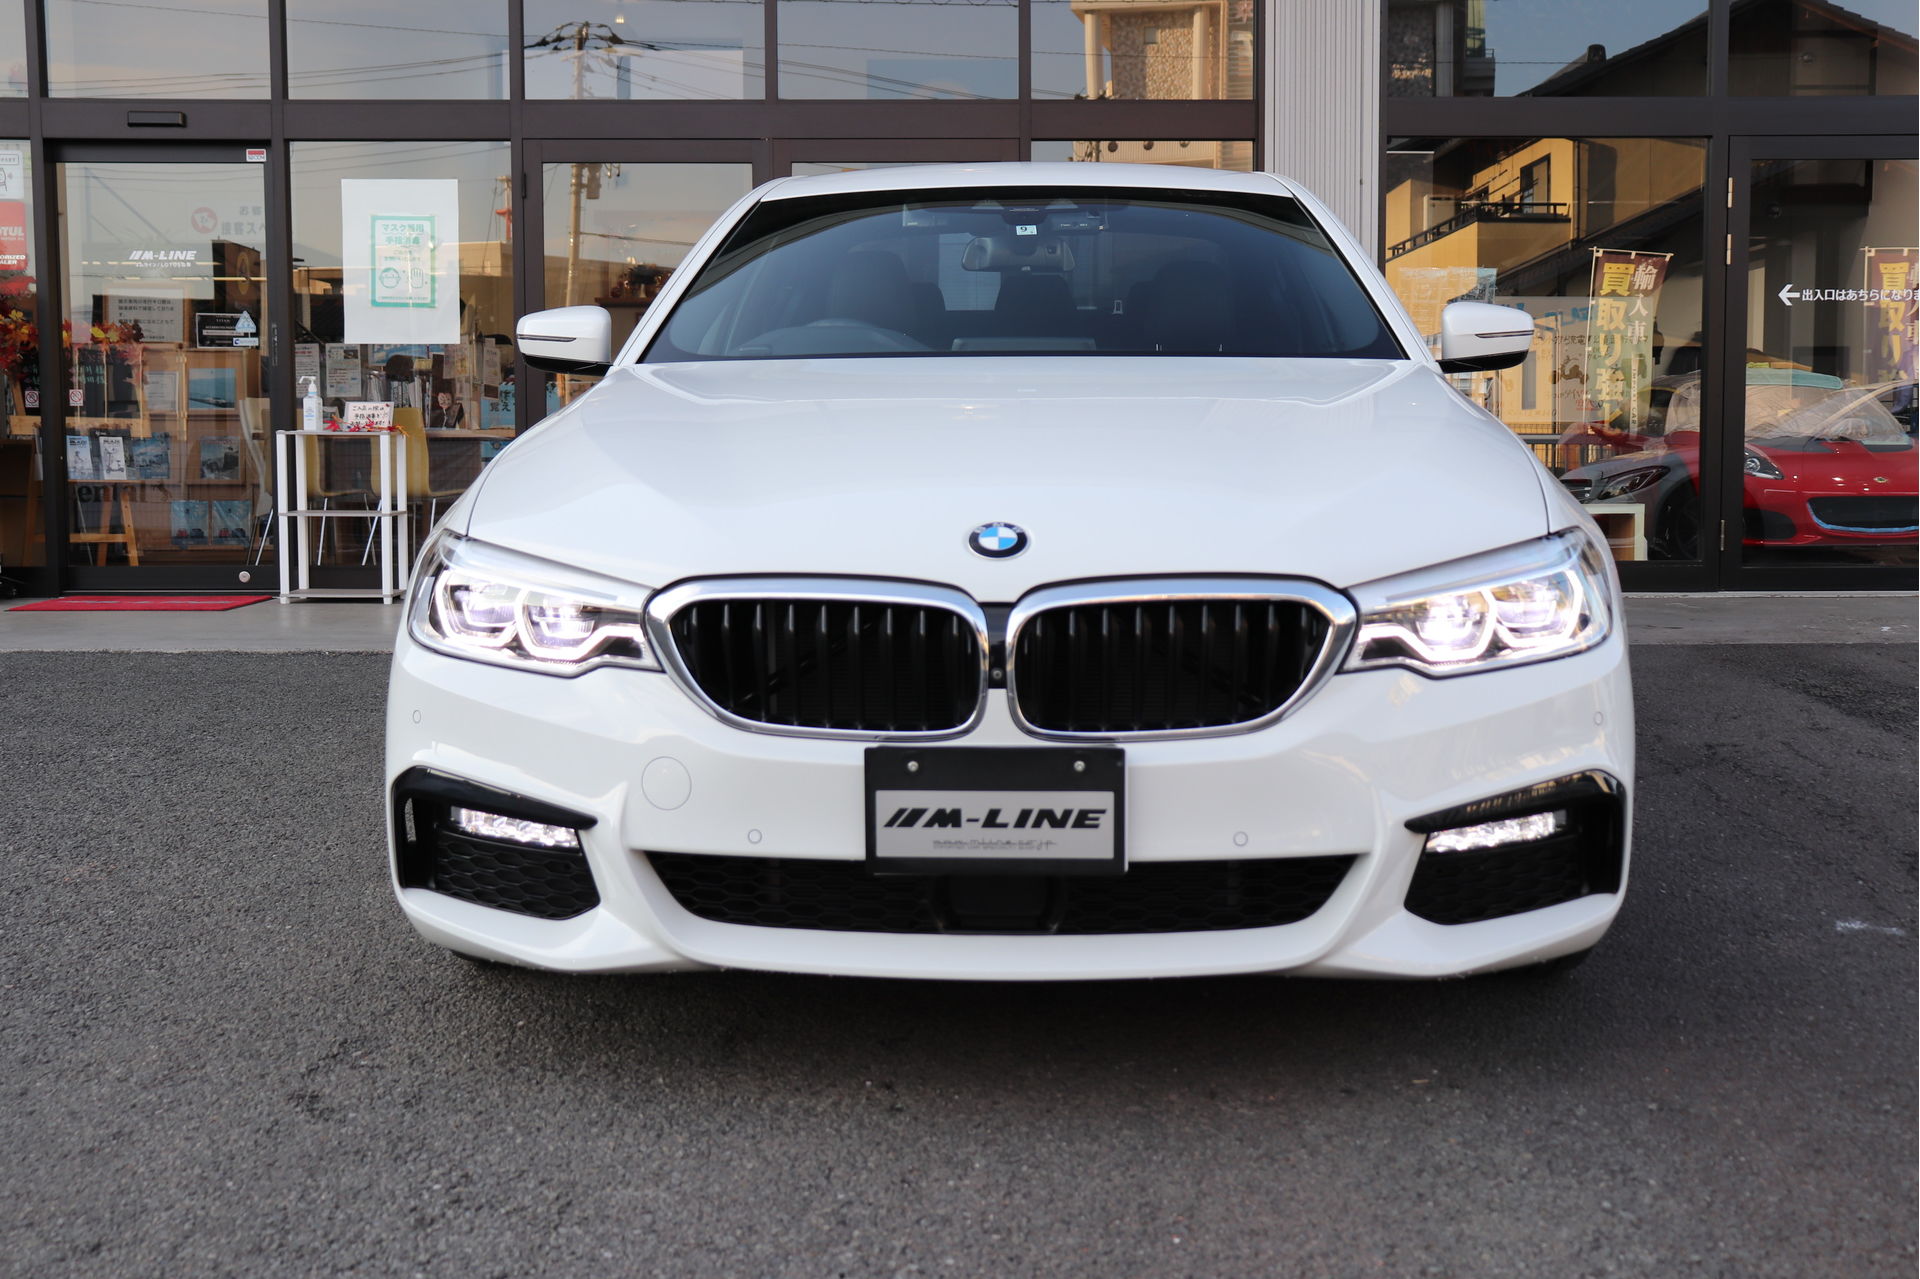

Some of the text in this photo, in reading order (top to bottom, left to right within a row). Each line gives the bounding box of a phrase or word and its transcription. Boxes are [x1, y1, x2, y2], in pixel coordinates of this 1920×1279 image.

[0, 226, 24, 236] TUL
[1626, 262, 1659, 344] 輸入車
